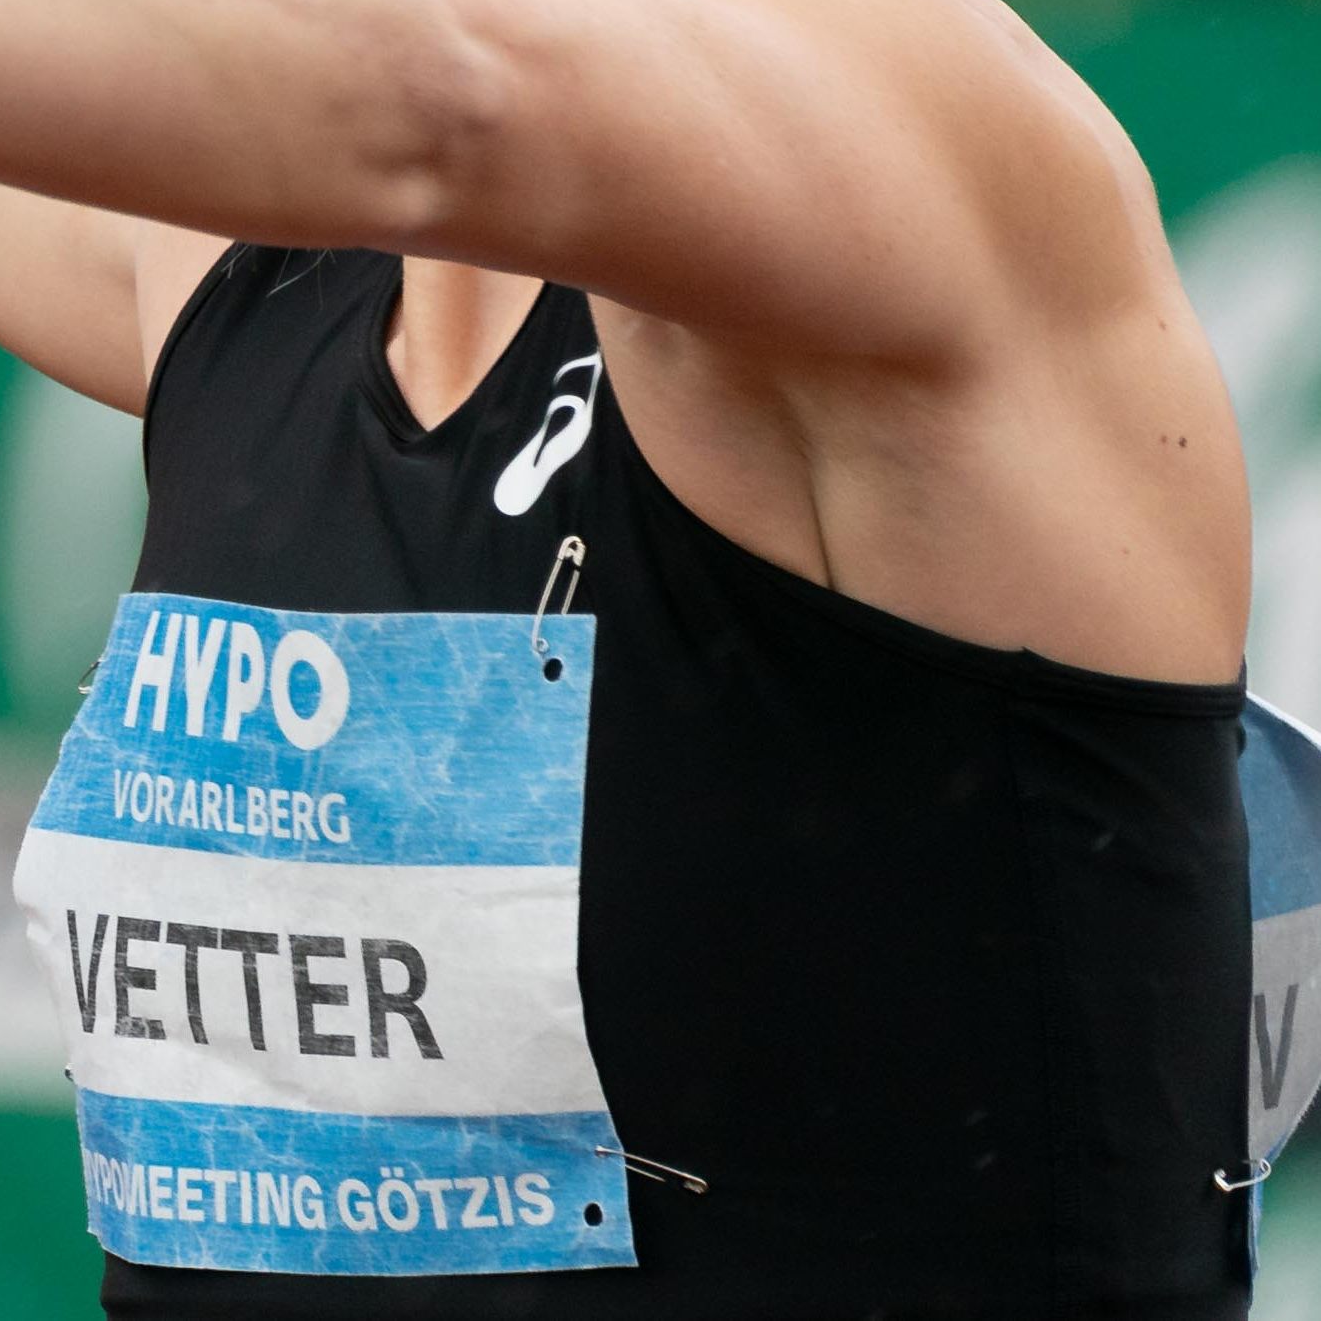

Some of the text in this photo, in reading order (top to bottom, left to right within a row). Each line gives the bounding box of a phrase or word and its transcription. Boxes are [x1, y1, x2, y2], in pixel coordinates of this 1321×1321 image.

[124, 610, 350, 751] HYPO
[113, 769, 351, 843] VORARLBERG
[66, 909, 444, 1059] VETTER
[82, 1148, 555, 1231] YPOMEETING GÖTZIS
